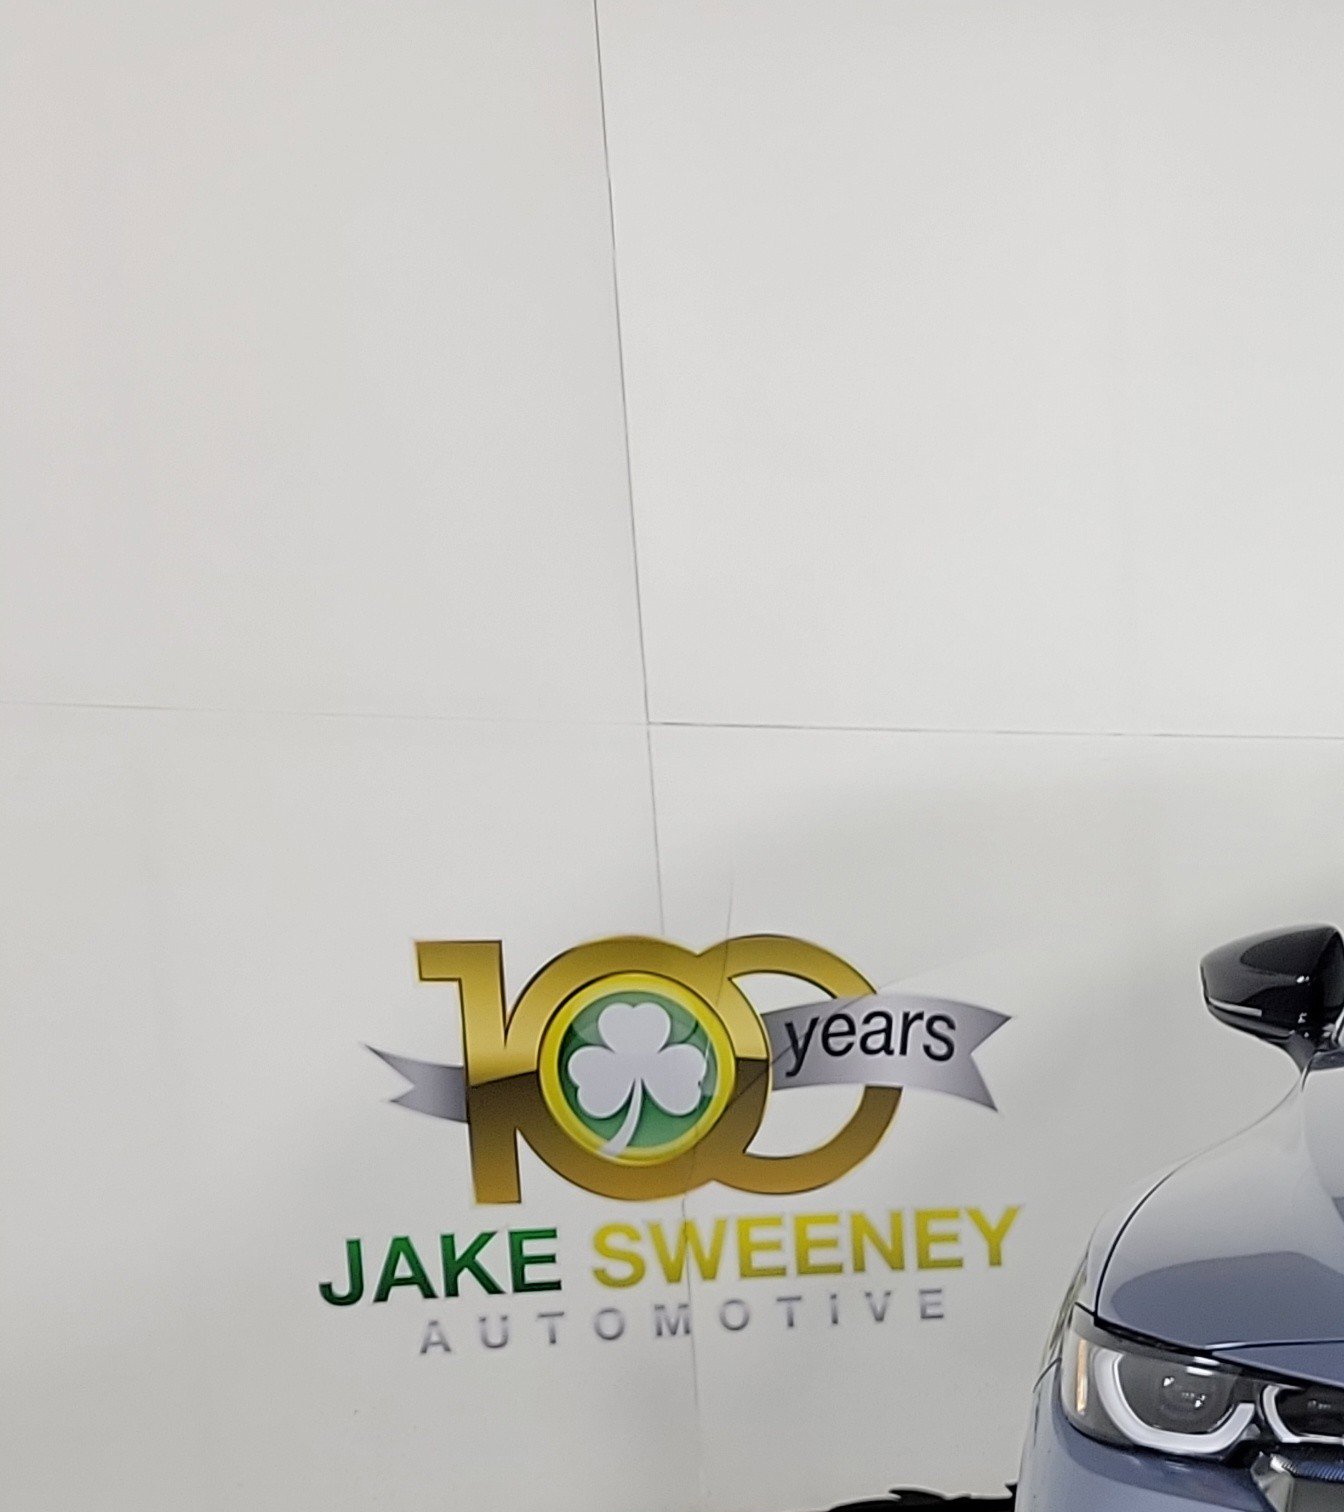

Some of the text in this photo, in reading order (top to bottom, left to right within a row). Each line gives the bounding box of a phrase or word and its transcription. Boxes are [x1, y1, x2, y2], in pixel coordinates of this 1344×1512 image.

[414, 934, 957, 1204] 100 years
[319, 1205, 1022, 1307] JAKE SWEENEY
[419, 1288, 946, 1356] AUTOMOTIVE
